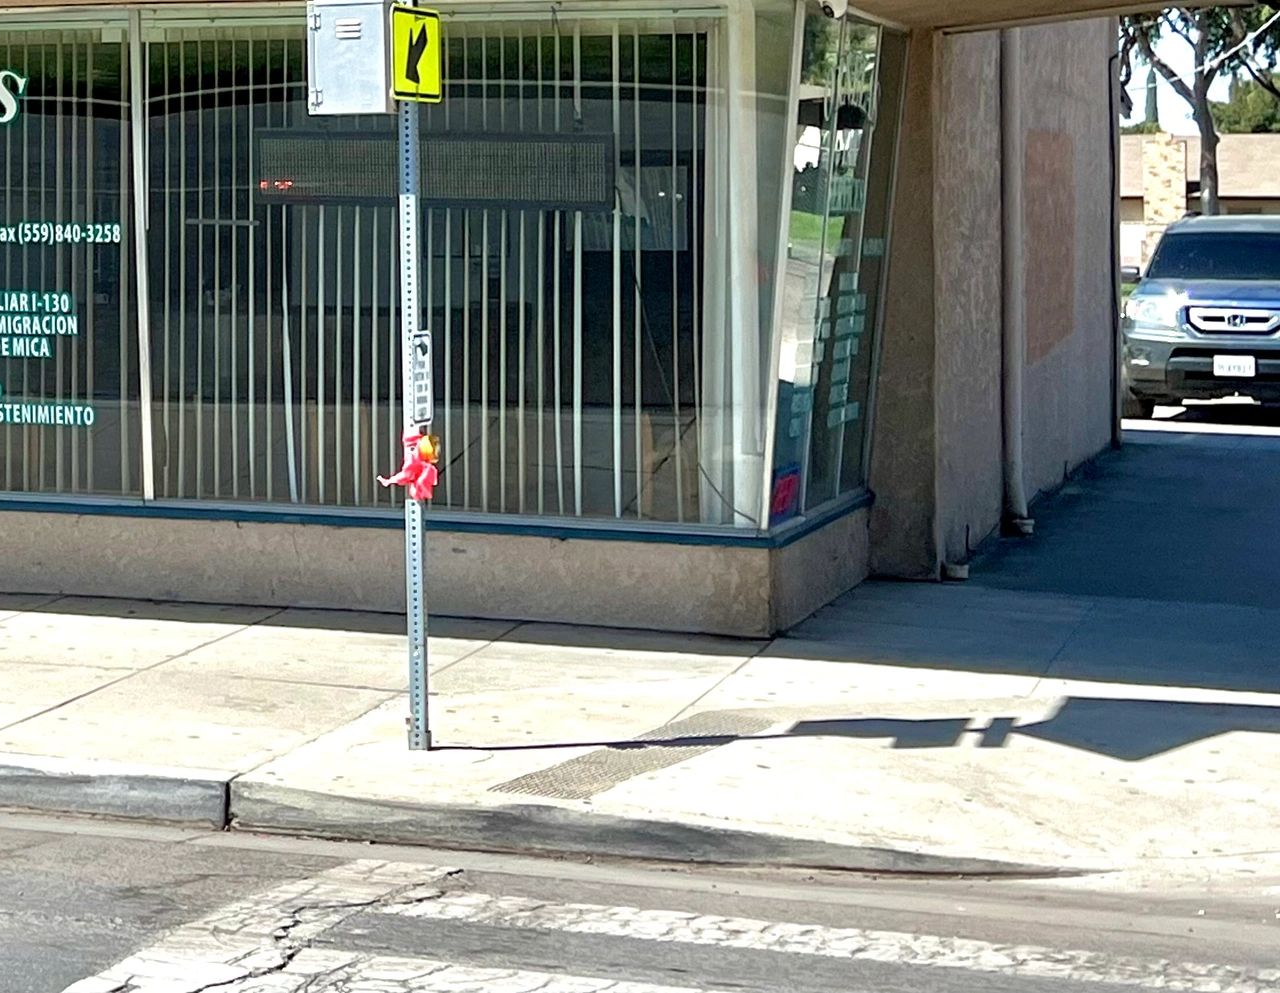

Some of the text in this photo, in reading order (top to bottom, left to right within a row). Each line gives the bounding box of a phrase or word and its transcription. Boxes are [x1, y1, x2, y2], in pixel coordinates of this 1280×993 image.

[18, 222, 54, 245] (559)
[55, 224, 121, 243] 840-3258
[32, 293, 69, 312] I-130
[12, 338, 50, 357] MICA
